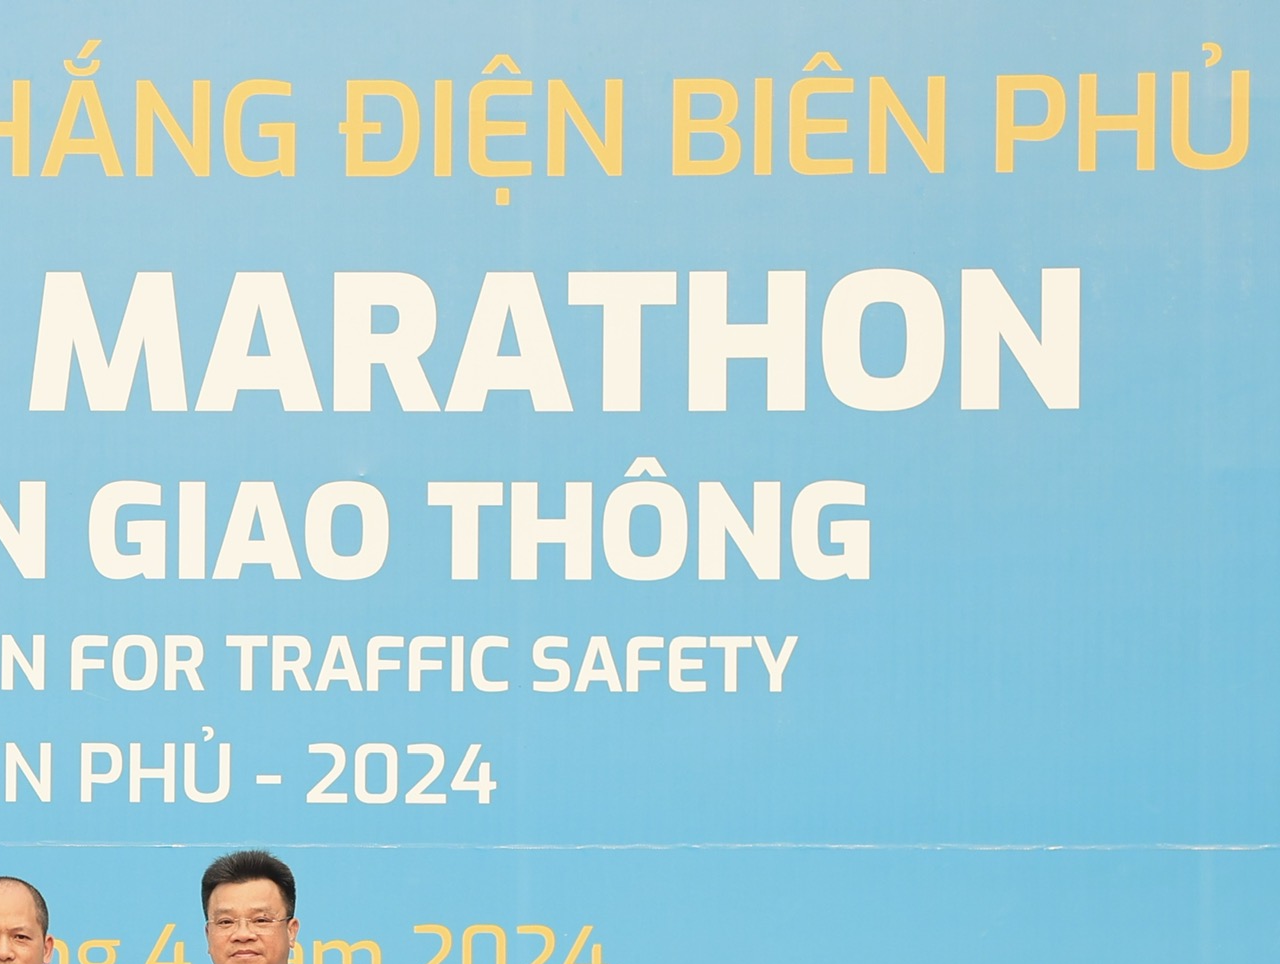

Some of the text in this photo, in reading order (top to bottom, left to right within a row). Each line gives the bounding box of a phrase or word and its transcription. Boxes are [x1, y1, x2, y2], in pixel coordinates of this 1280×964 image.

[338, 53, 626, 208] ĐIỆN
[672, 51, 949, 178] BIÊN
[995, 41, 1253, 175] PHỦ
[30, 266, 1084, 414] MARATHON
[88, 480, 392, 582] GIAO
[427, 456, 873, 583] THÔNG
[71, 634, 207, 693] FOR
[226, 634, 512, 694] TRAFFIC
[532, 636, 800, 694] SAFETY
[81, 727, 234, 805] PHỦ
[307, 743, 499, 806] 2024
